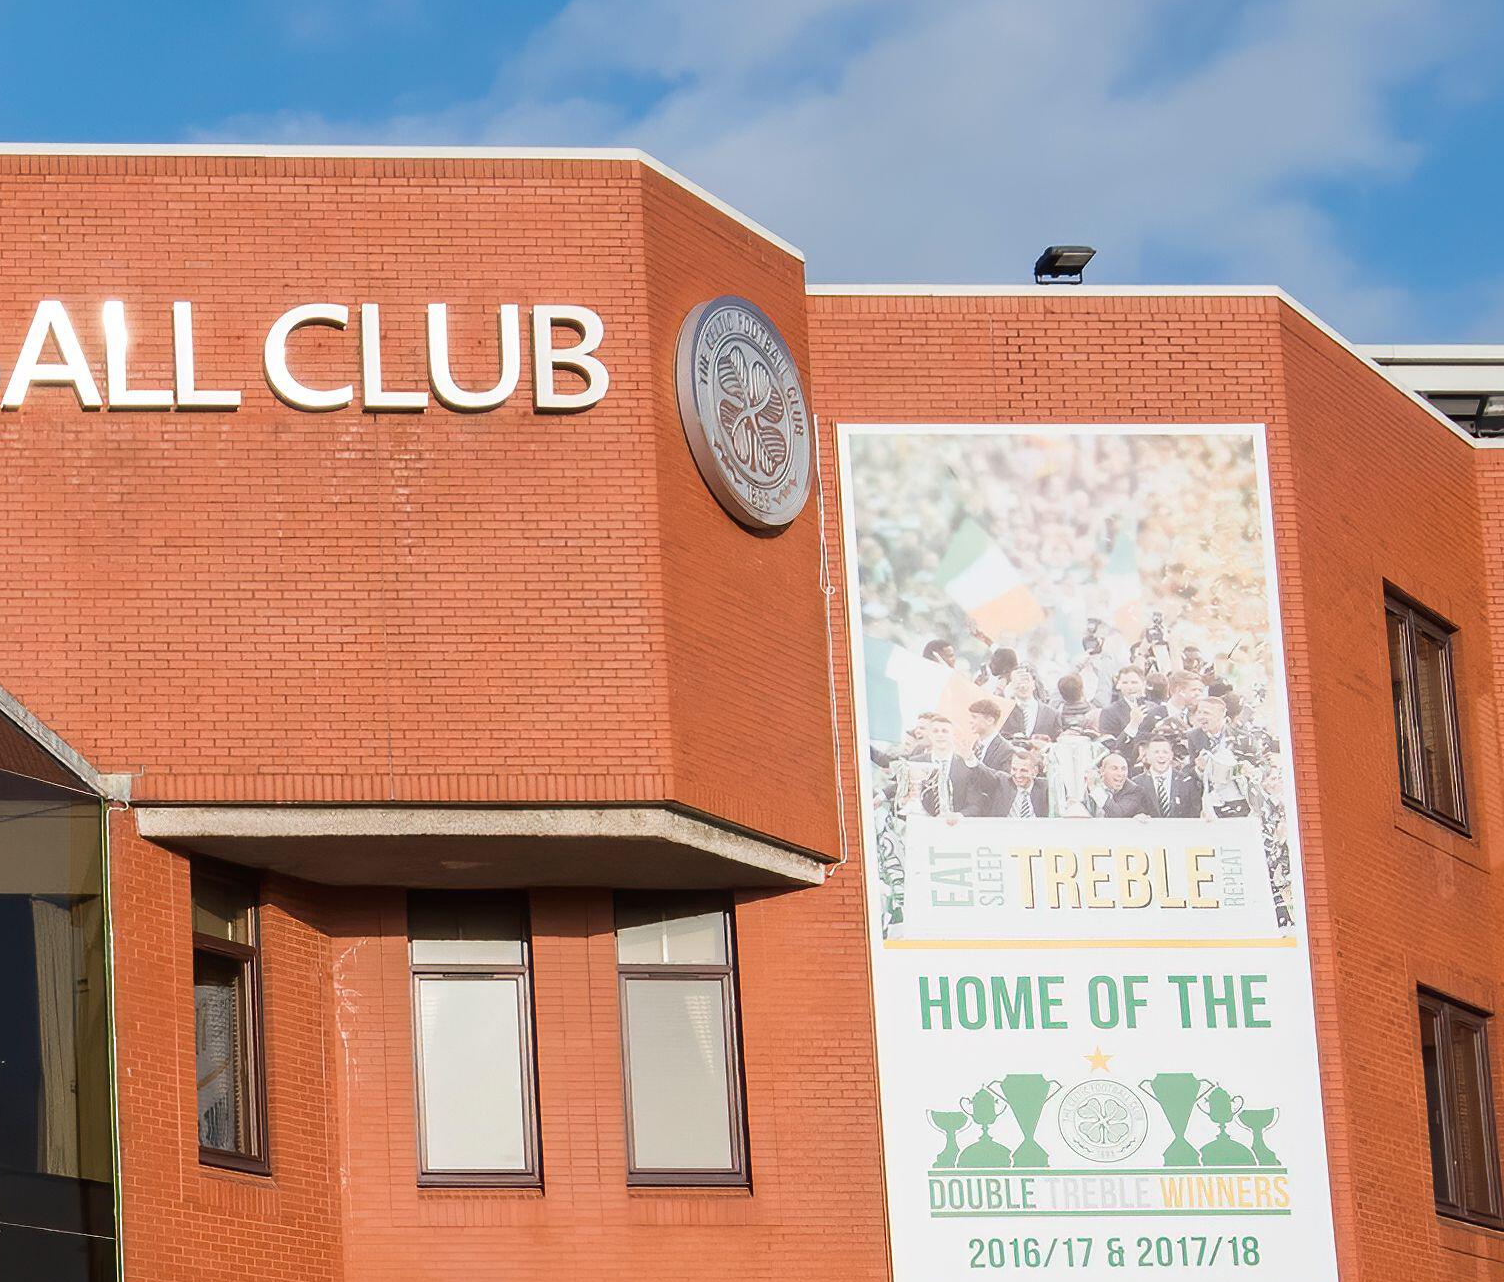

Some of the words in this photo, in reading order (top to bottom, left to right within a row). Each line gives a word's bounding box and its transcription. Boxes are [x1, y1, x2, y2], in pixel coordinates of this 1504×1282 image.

[262, 301, 610, 414] CLUB
[931, 846, 975, 907] EAT
[979, 846, 1005, 907] SLEEP
[1010, 846, 1220, 909] TREBLE
[1220, 845, 1246, 907] REPEAT
[918, 975, 1069, 1030] HOME
[1088, 975, 1149, 1029] OF
[1167, 974, 1272, 1029] THE
[928, 1177, 1037, 1210] DOUBLE
[1044, 1177, 1150, 1209] TREBLE
[1159, 1175, 1290, 1209] WINNERS
[968, 1237, 1093, 1268] 2016/17
[1107, 1237, 1125, 1267] &
[1136, 1236, 1260, 1267] 2017/18
